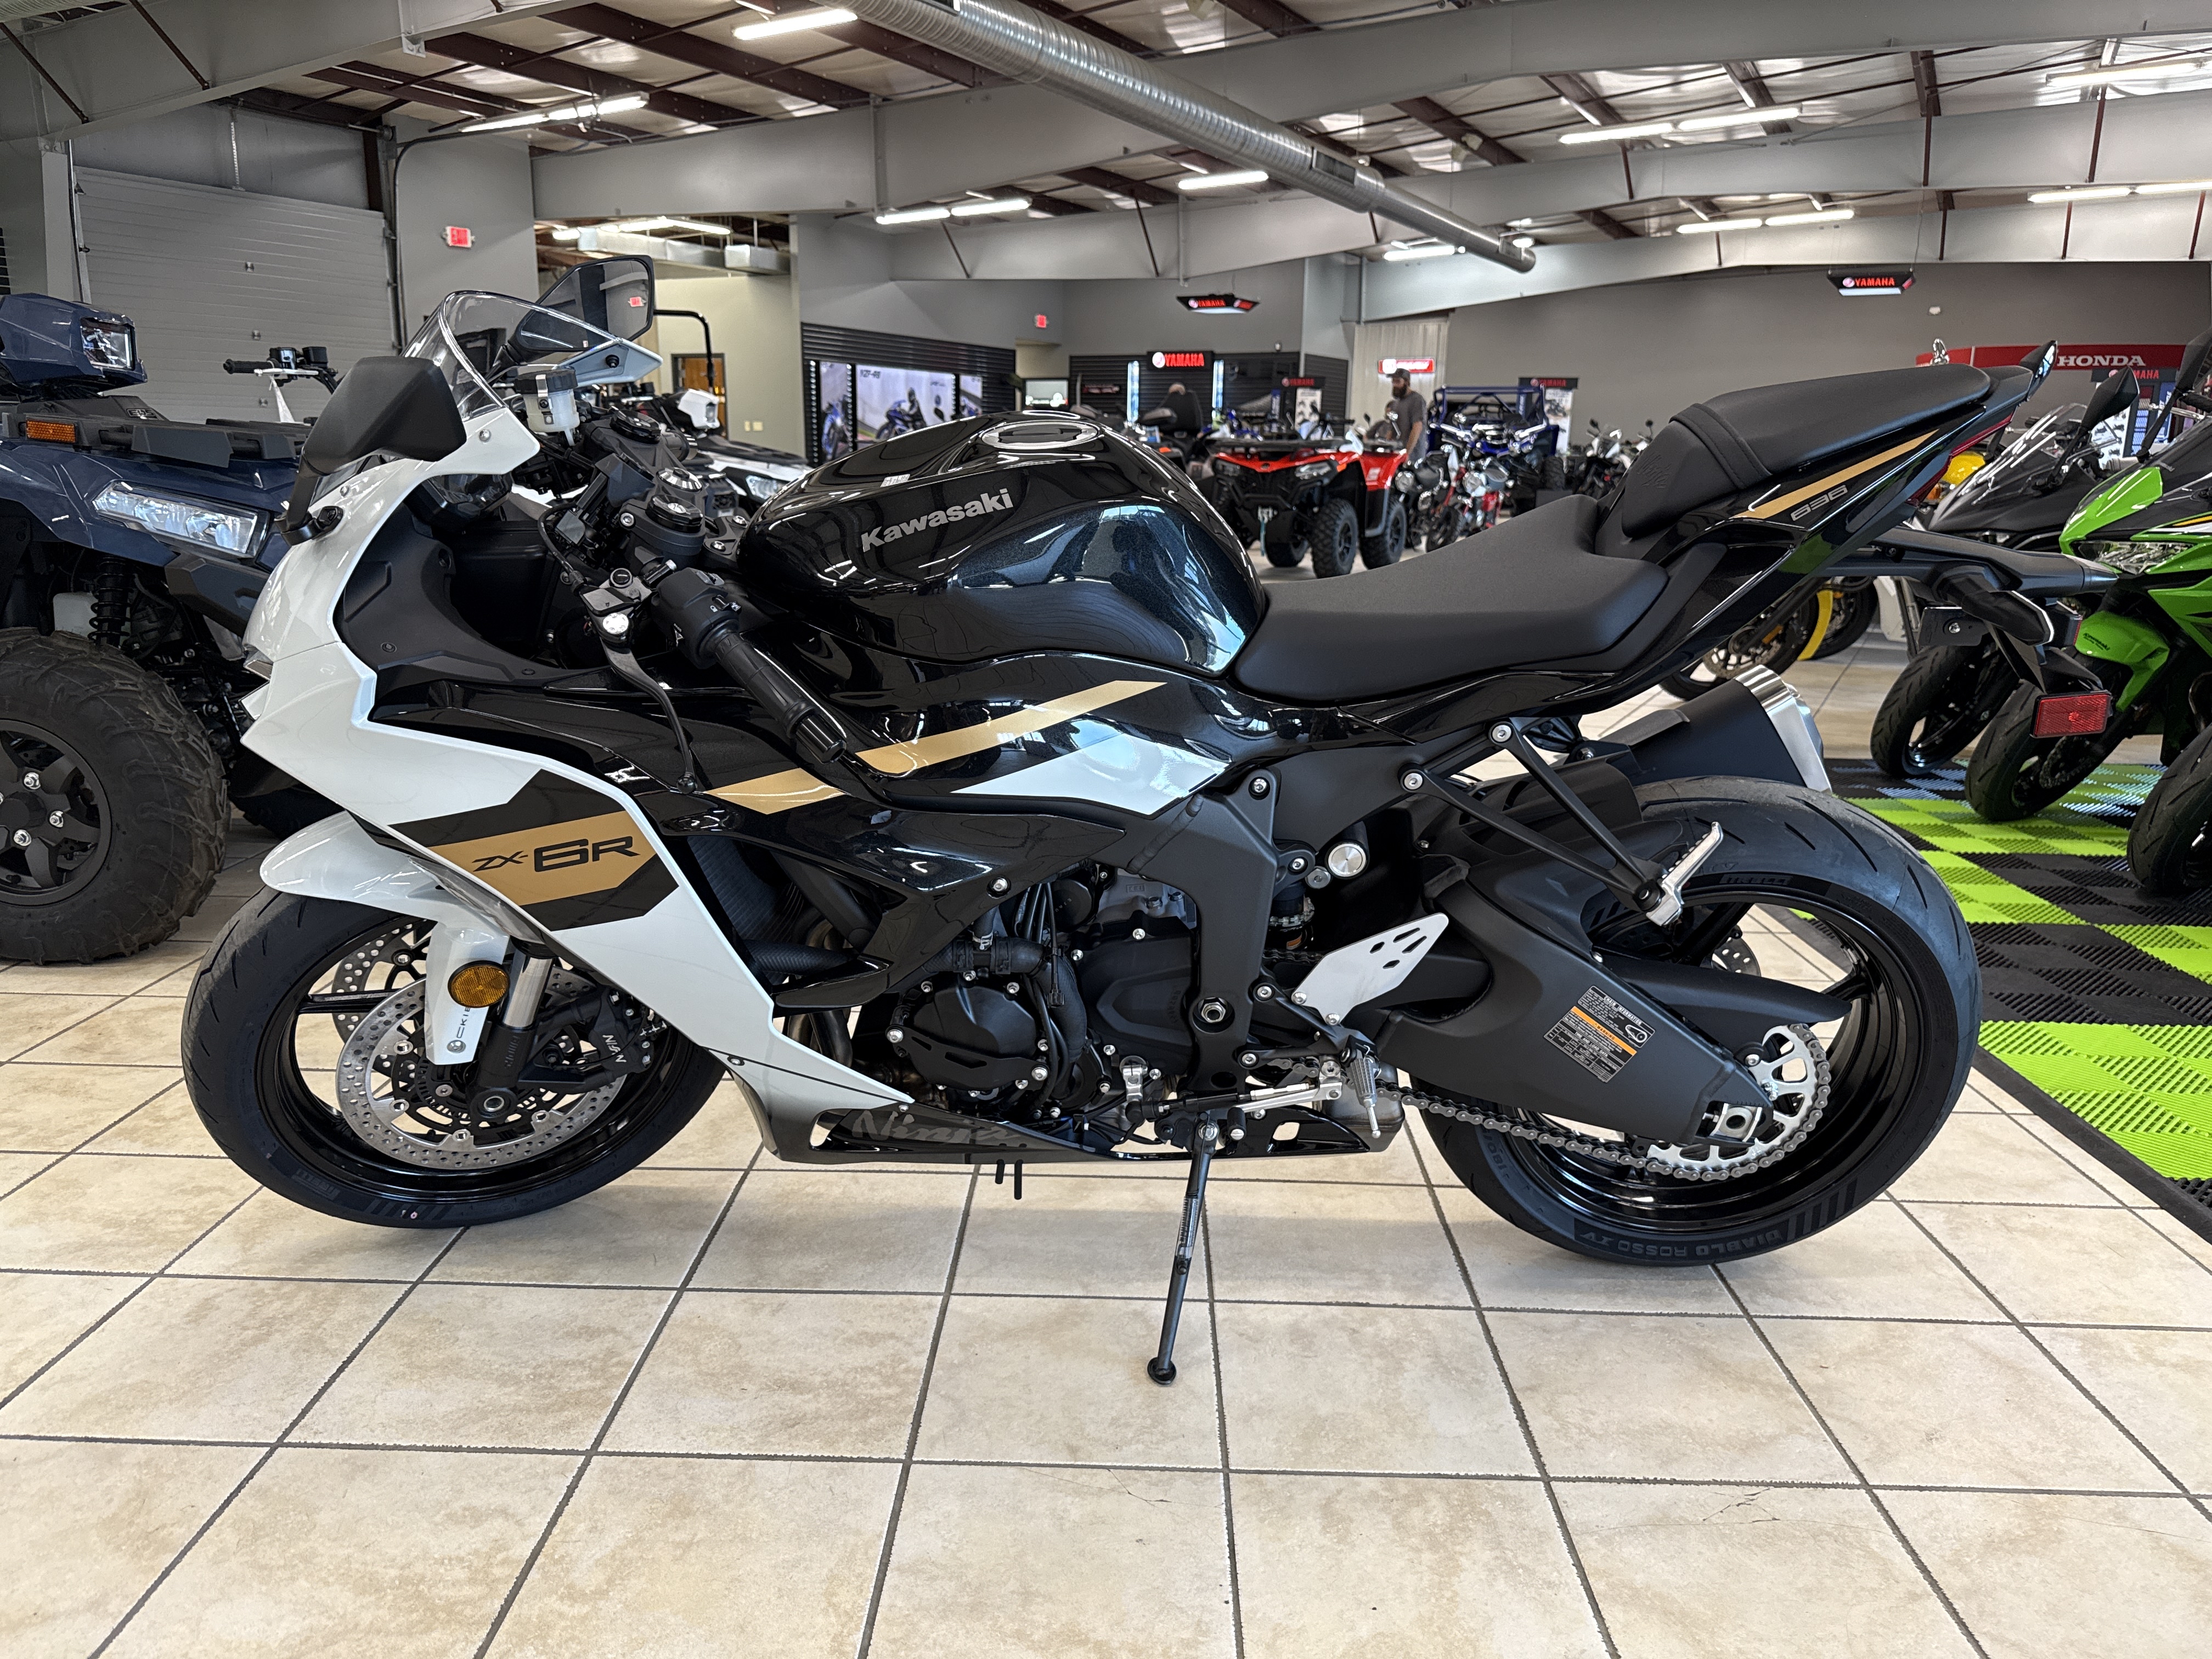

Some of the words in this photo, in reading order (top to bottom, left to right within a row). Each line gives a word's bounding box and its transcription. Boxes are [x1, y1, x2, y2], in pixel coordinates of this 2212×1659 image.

[1855, 278, 1895, 286] YAMAHA
[1165, 353, 1204, 367] YAMAHA
[2057, 355, 2146, 367] HONDA
[1289, 378, 1315, 387] YAMAHA
[2133, 370, 2159, 379] MAHA
[1791, 484, 1848, 521] 636
[861, 488, 1014, 552] Kawasaki
[472, 836, 641, 872] ZX-6R
[1604, 996, 1616, 1007] CHAIN
[1617, 1005, 1642, 1025] INFORMATION
[1597, 1025, 1615, 1040] WARNING
[1590, 1041, 1600, 1051] LOAD
[851, 1109, 1022, 1146] Ninja
[1618, 1240, 1688, 1257] ROSSO
[1696, 1228, 1782, 1256] DIABLO
